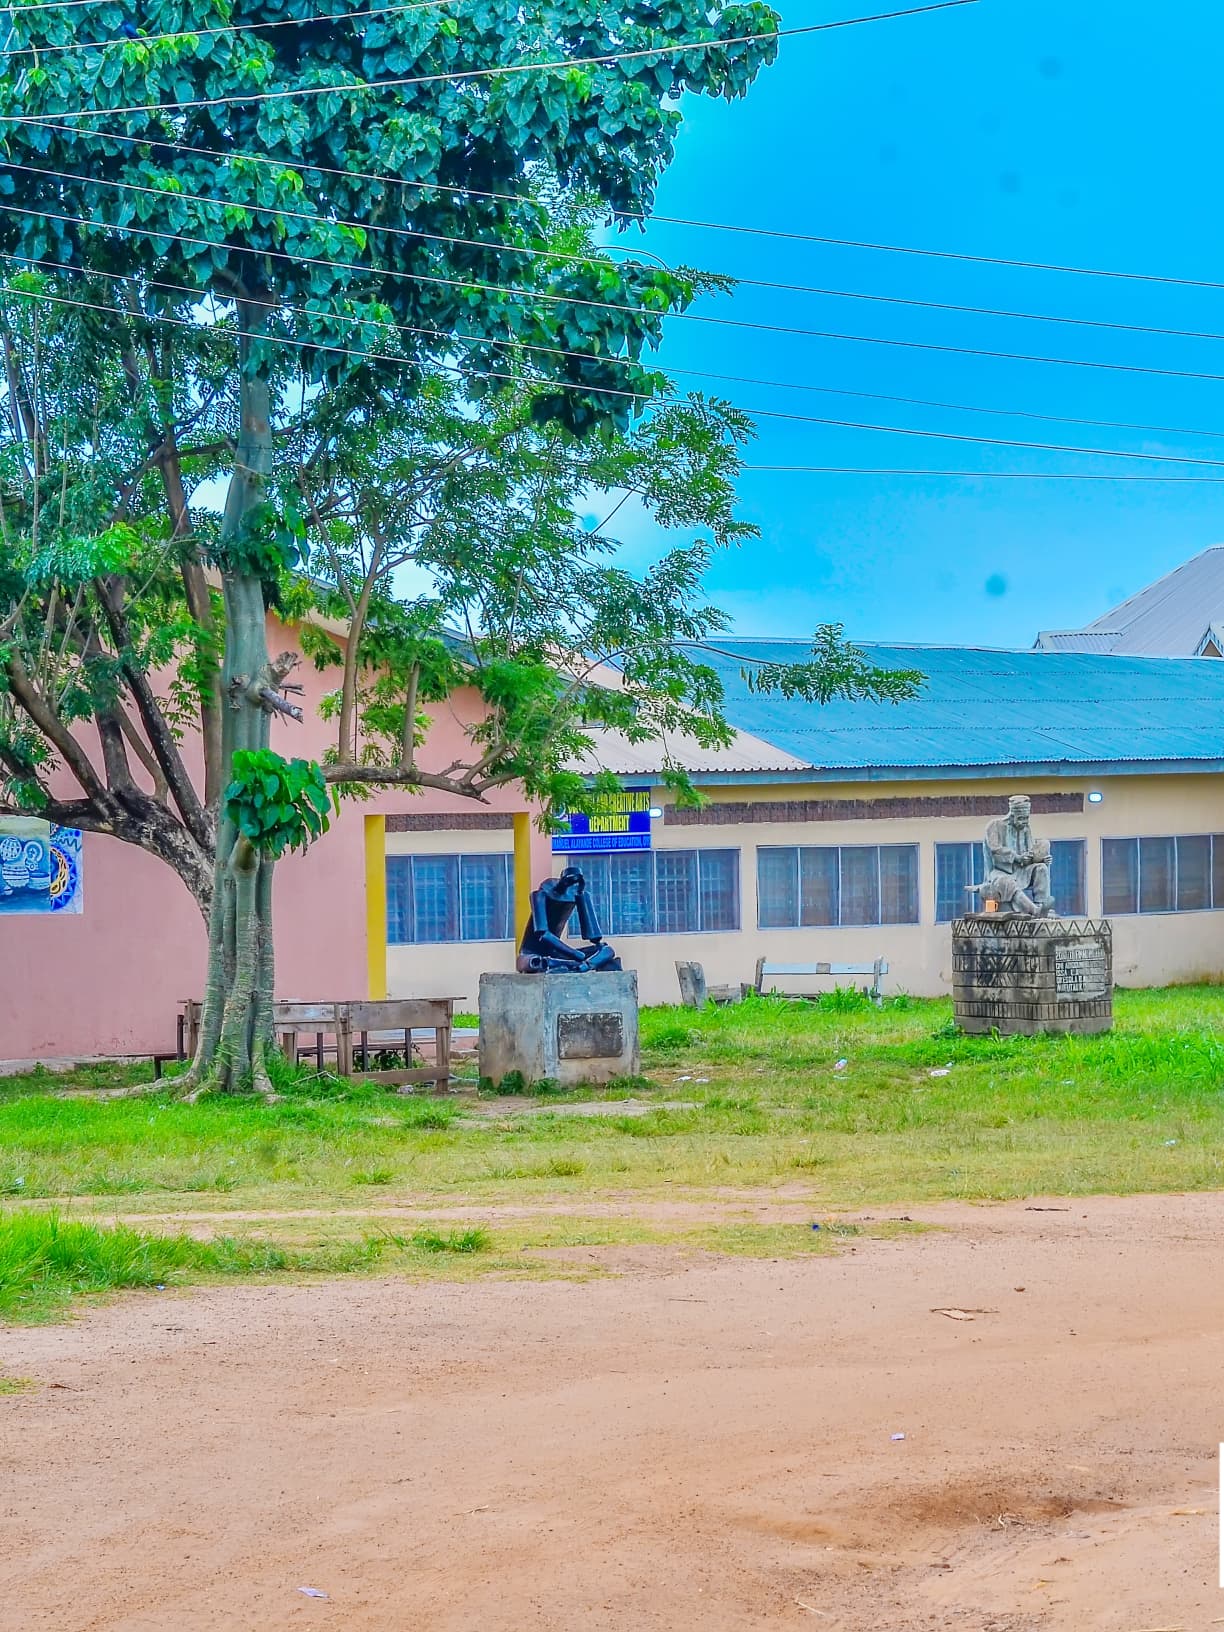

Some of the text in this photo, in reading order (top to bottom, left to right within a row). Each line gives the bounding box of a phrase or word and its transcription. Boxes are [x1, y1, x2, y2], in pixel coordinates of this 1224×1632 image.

[609, 792, 634, 812] CREATIVE
[636, 792, 649, 811] ARTS
[589, 815, 630, 832] DEPARTMENT
[592, 837, 610, 848] COLLEGE
[611, 837, 617, 847] OF
